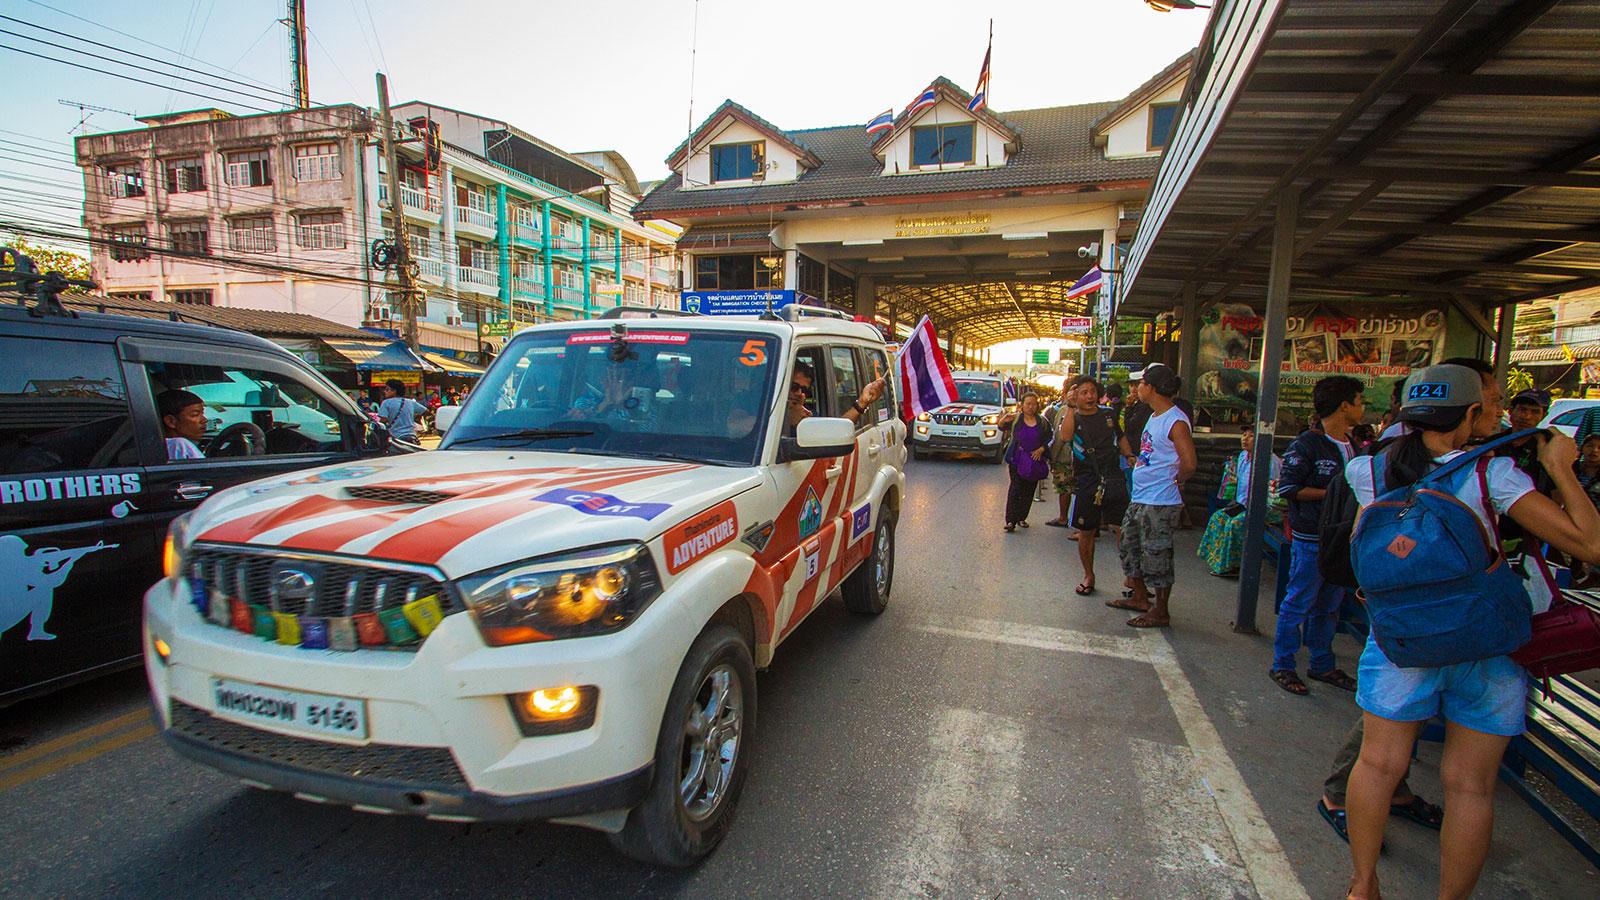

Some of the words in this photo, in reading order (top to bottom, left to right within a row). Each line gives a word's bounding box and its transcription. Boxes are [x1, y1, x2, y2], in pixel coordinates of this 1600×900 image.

[739, 340, 766, 366] 5
[1411, 385, 1443, 397] 424
[0, 473, 141, 504] ROTHERS
[565, 494, 640, 513] CEAT
[673, 518, 734, 568] ADVENTURE
[809, 558, 815, 575] 5
[307, 703, 358, 731] 5156
